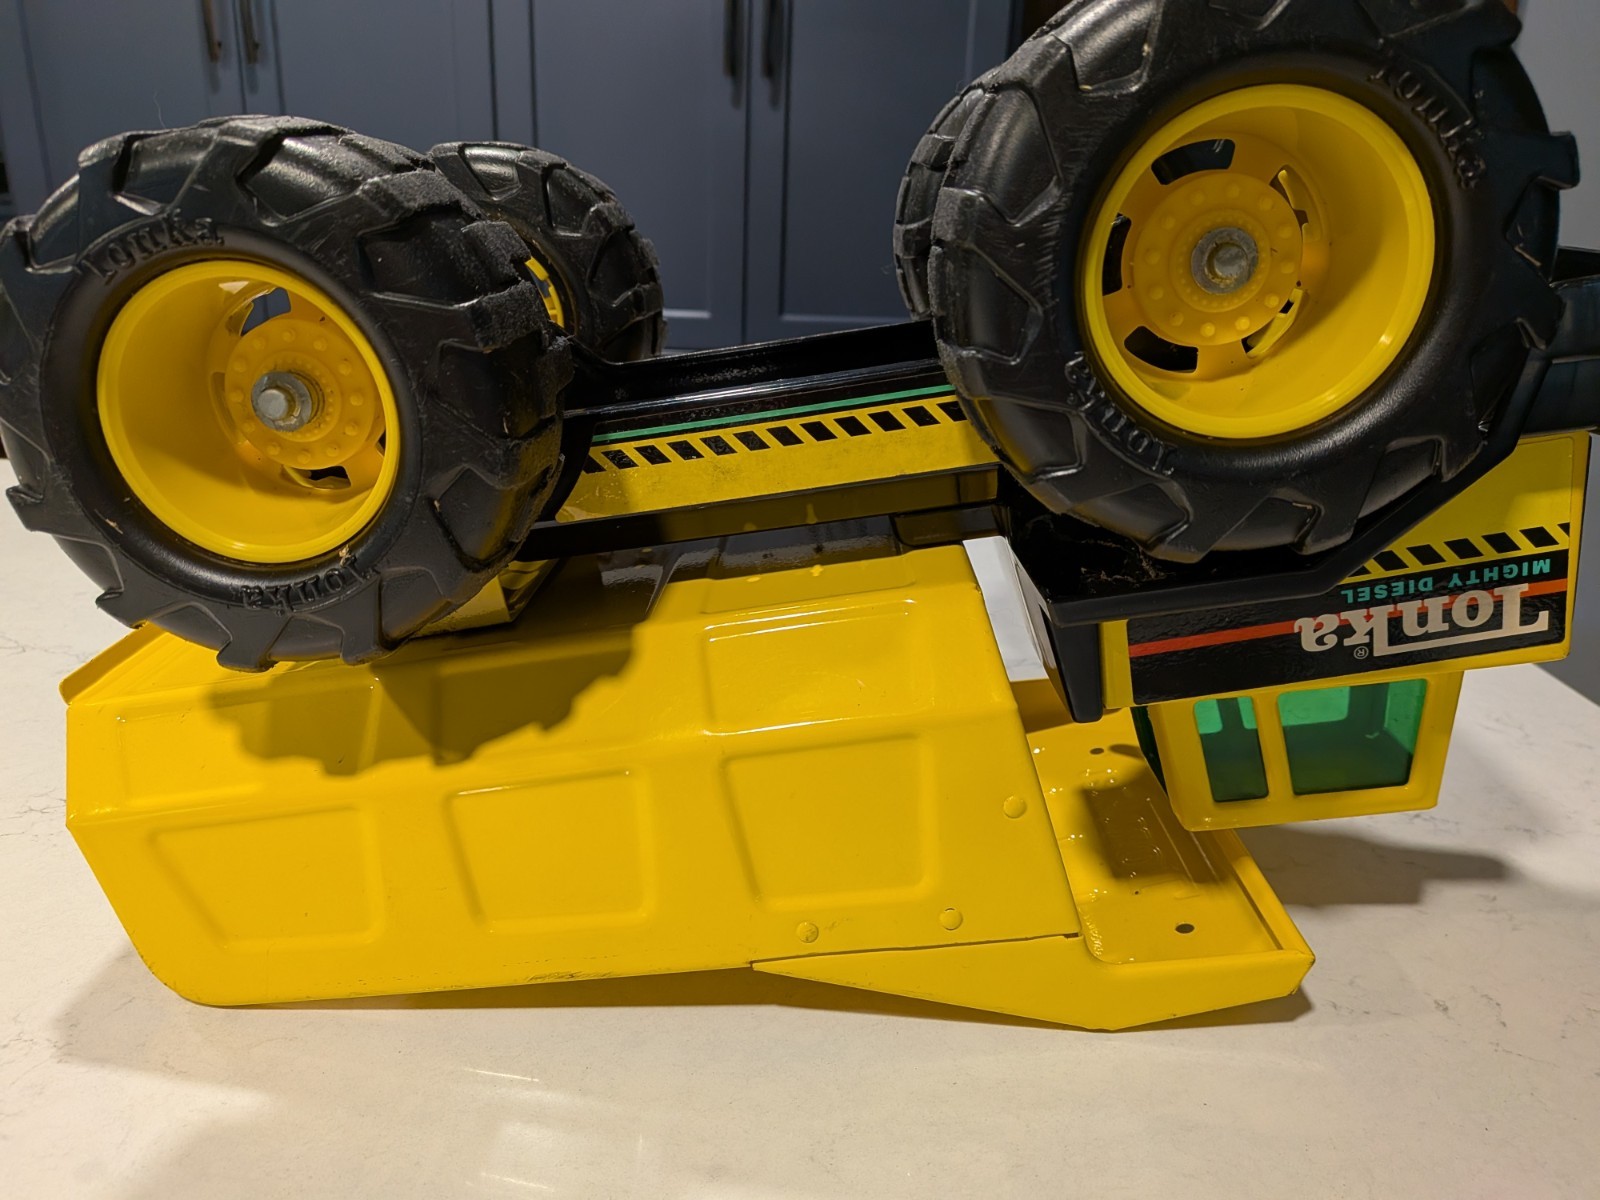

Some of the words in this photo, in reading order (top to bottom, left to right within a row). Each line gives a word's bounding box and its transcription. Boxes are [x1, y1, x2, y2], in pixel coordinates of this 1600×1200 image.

[1448, 558, 1551, 588] MIGHTY
[1340, 576, 1433, 604] DIESEL
[1293, 583, 1549, 657] Tonka
